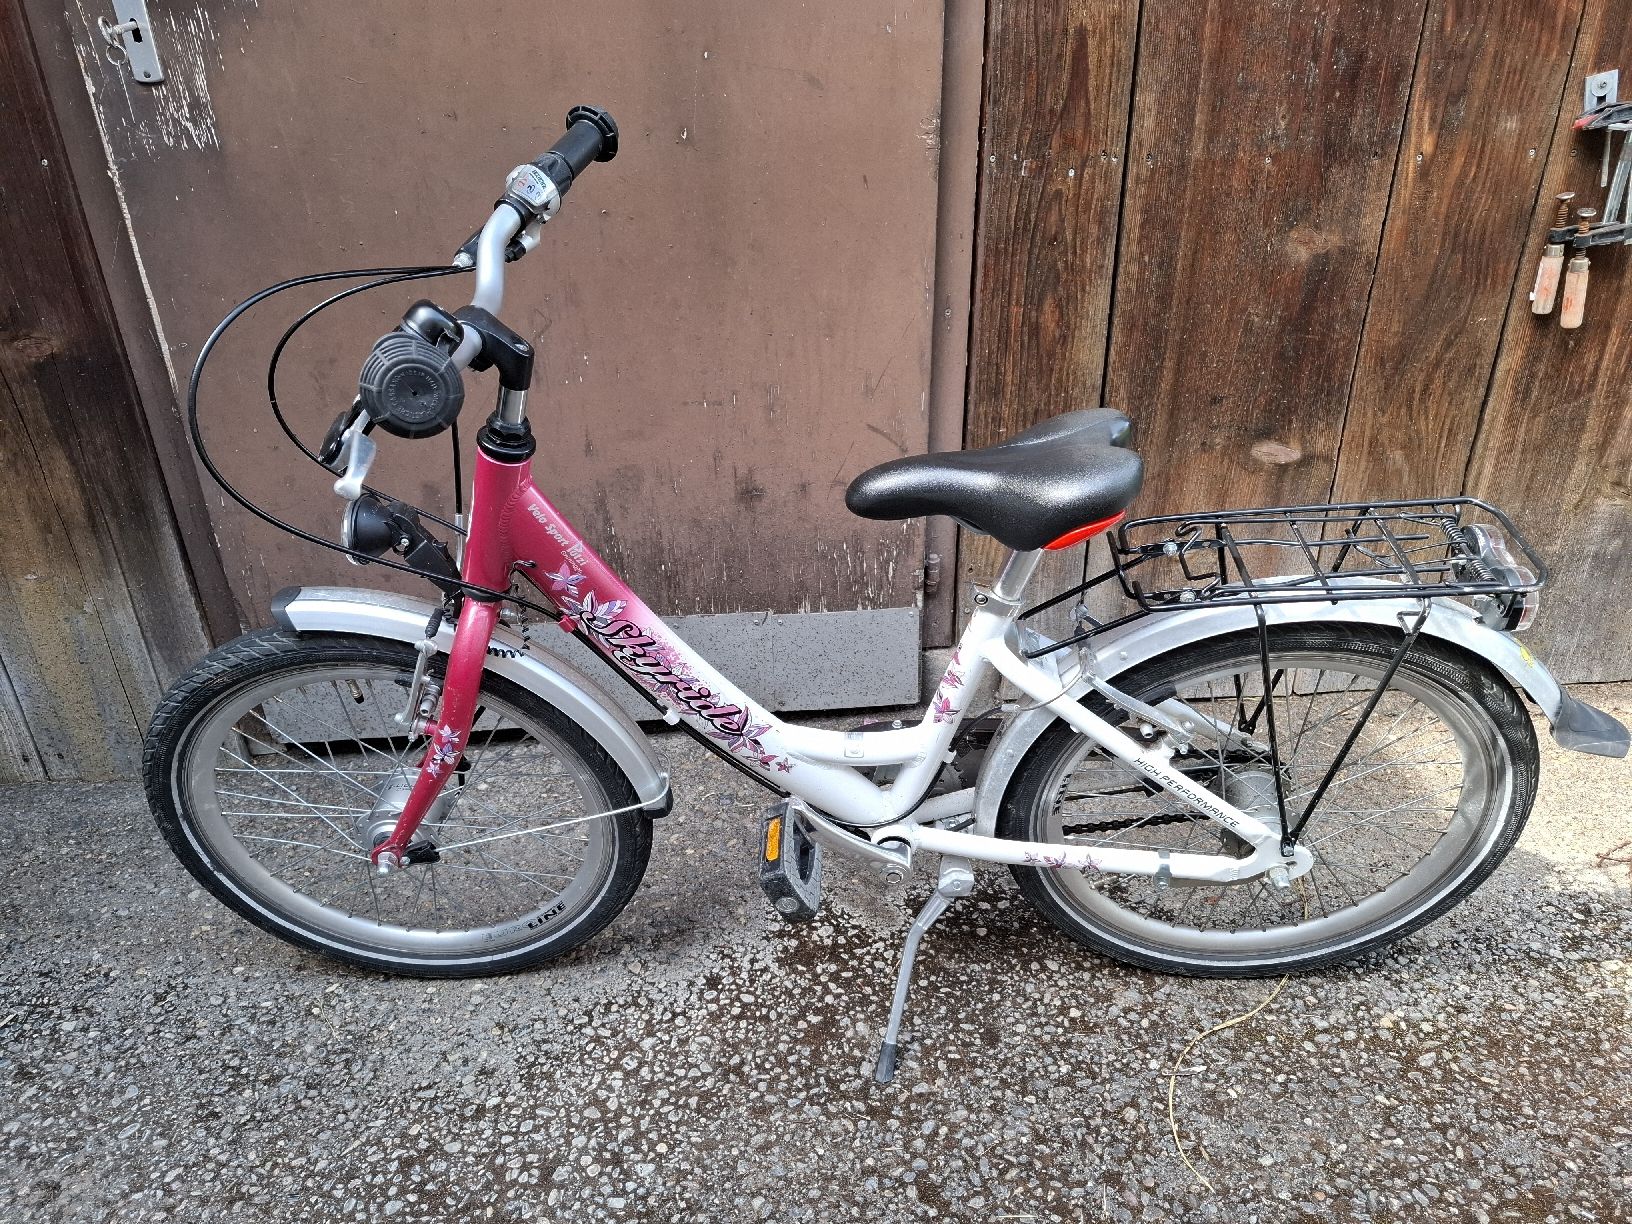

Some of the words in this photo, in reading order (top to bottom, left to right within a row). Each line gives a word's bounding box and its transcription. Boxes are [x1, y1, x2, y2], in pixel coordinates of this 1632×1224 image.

[527, 503, 547, 523] Velo
[544, 523, 570, 547] Sport
[579, 610, 744, 735] Skyride
[1133, 757, 1162, 777] HIGH
[1160, 775, 1240, 828] PERFORMANCE
[527, 900, 567, 931] LINE
